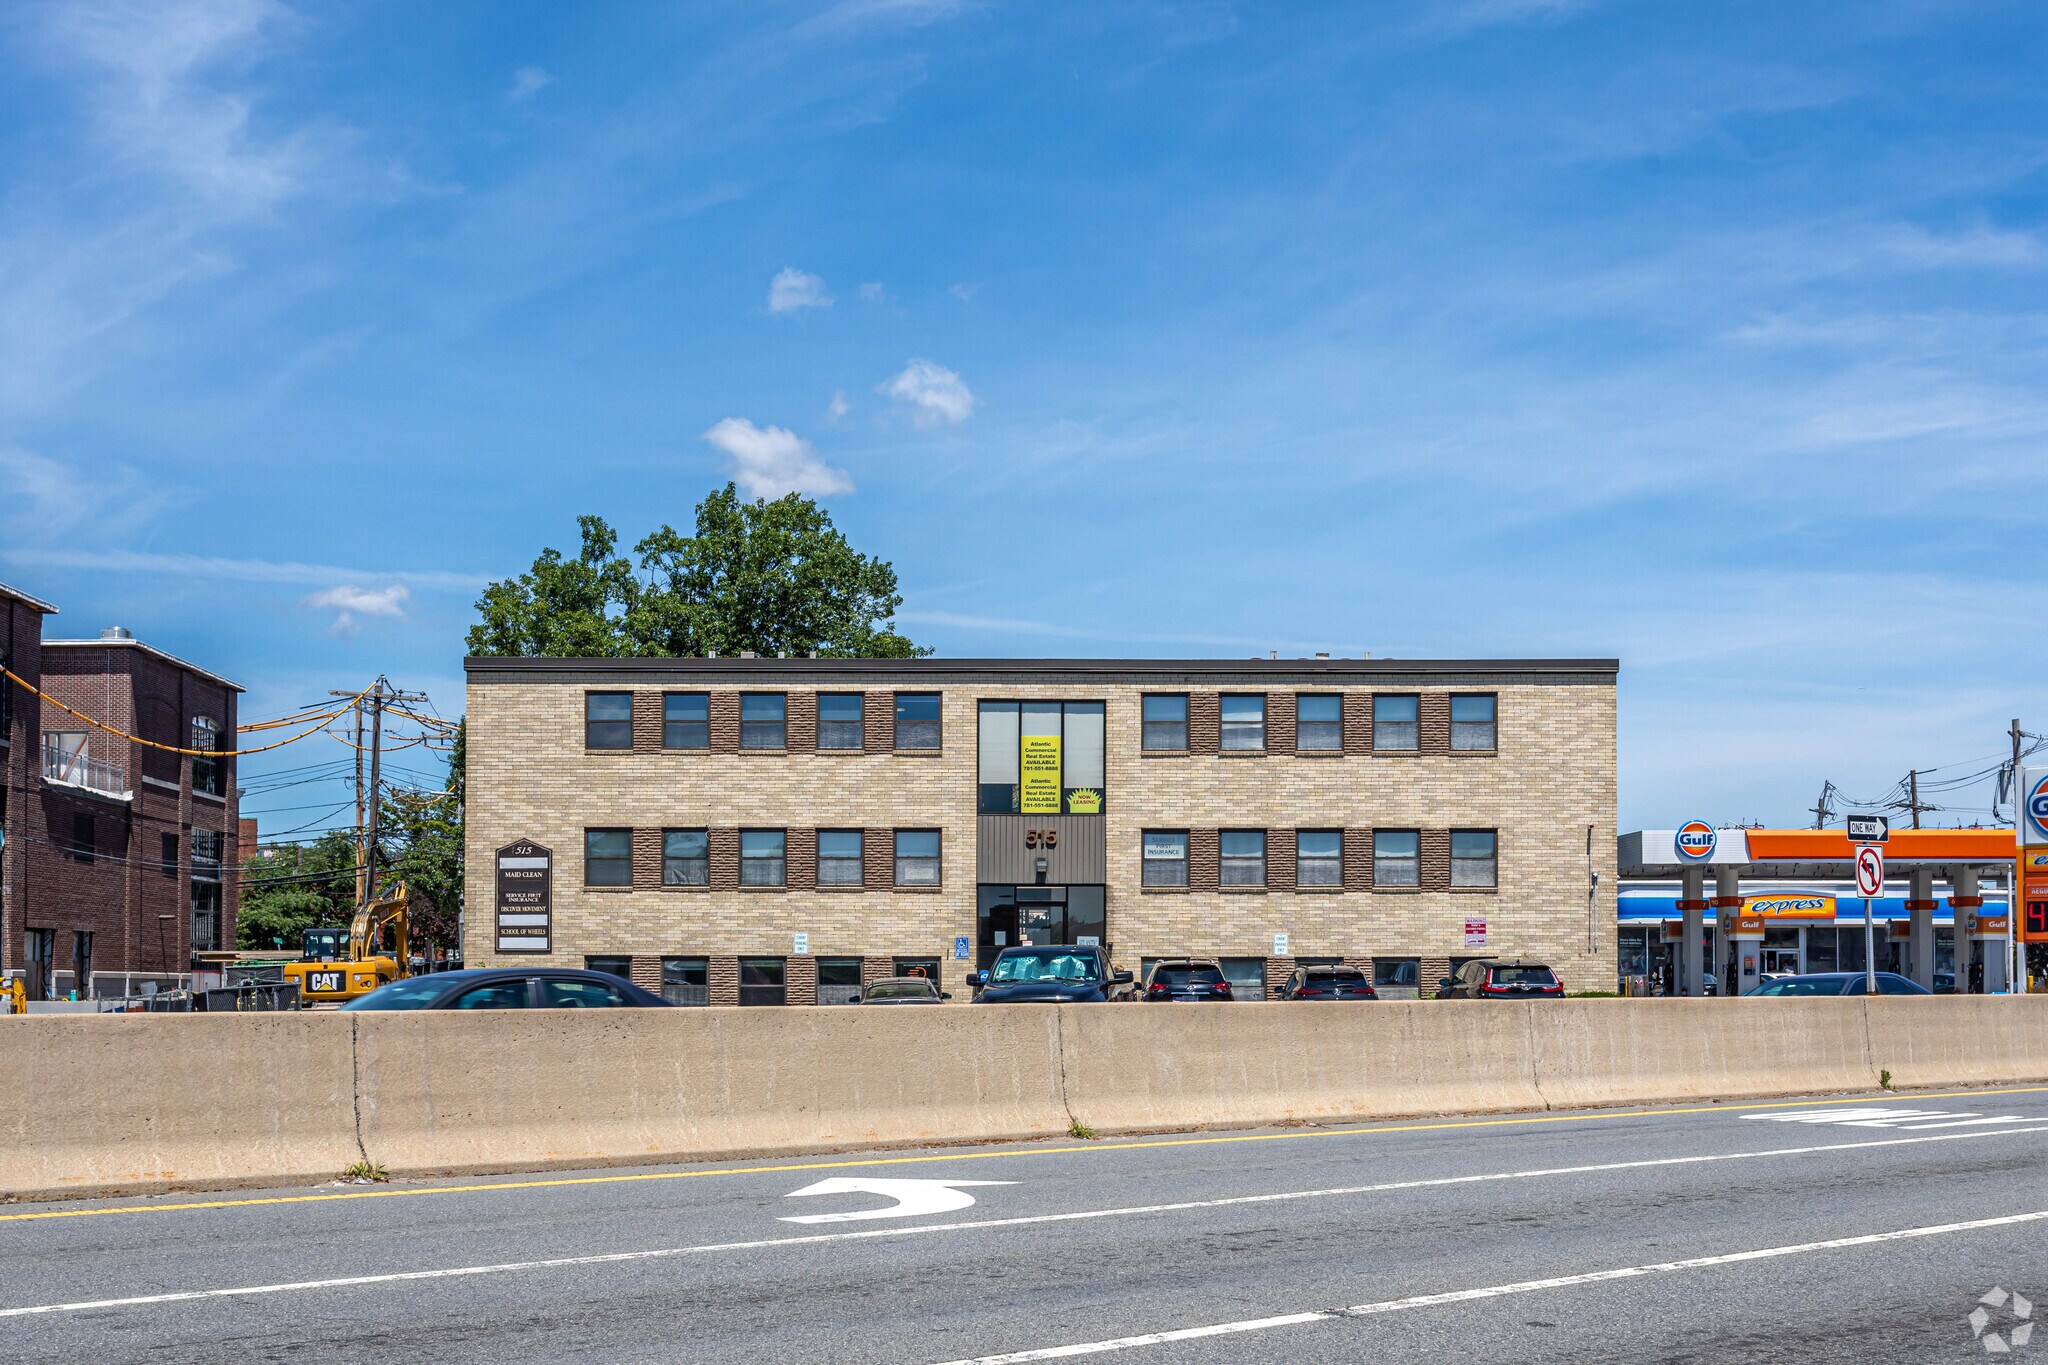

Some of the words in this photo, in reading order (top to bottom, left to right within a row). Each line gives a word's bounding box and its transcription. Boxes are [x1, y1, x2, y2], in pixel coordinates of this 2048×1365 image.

[1852, 823, 1863, 832] ONE
[1864, 824, 1876, 833] WAY
[1026, 829, 1057, 846] 515
[1680, 834, 1713, 845] Gulf
[1752, 898, 1825, 914] express
[312, 973, 339, 991] CAT
